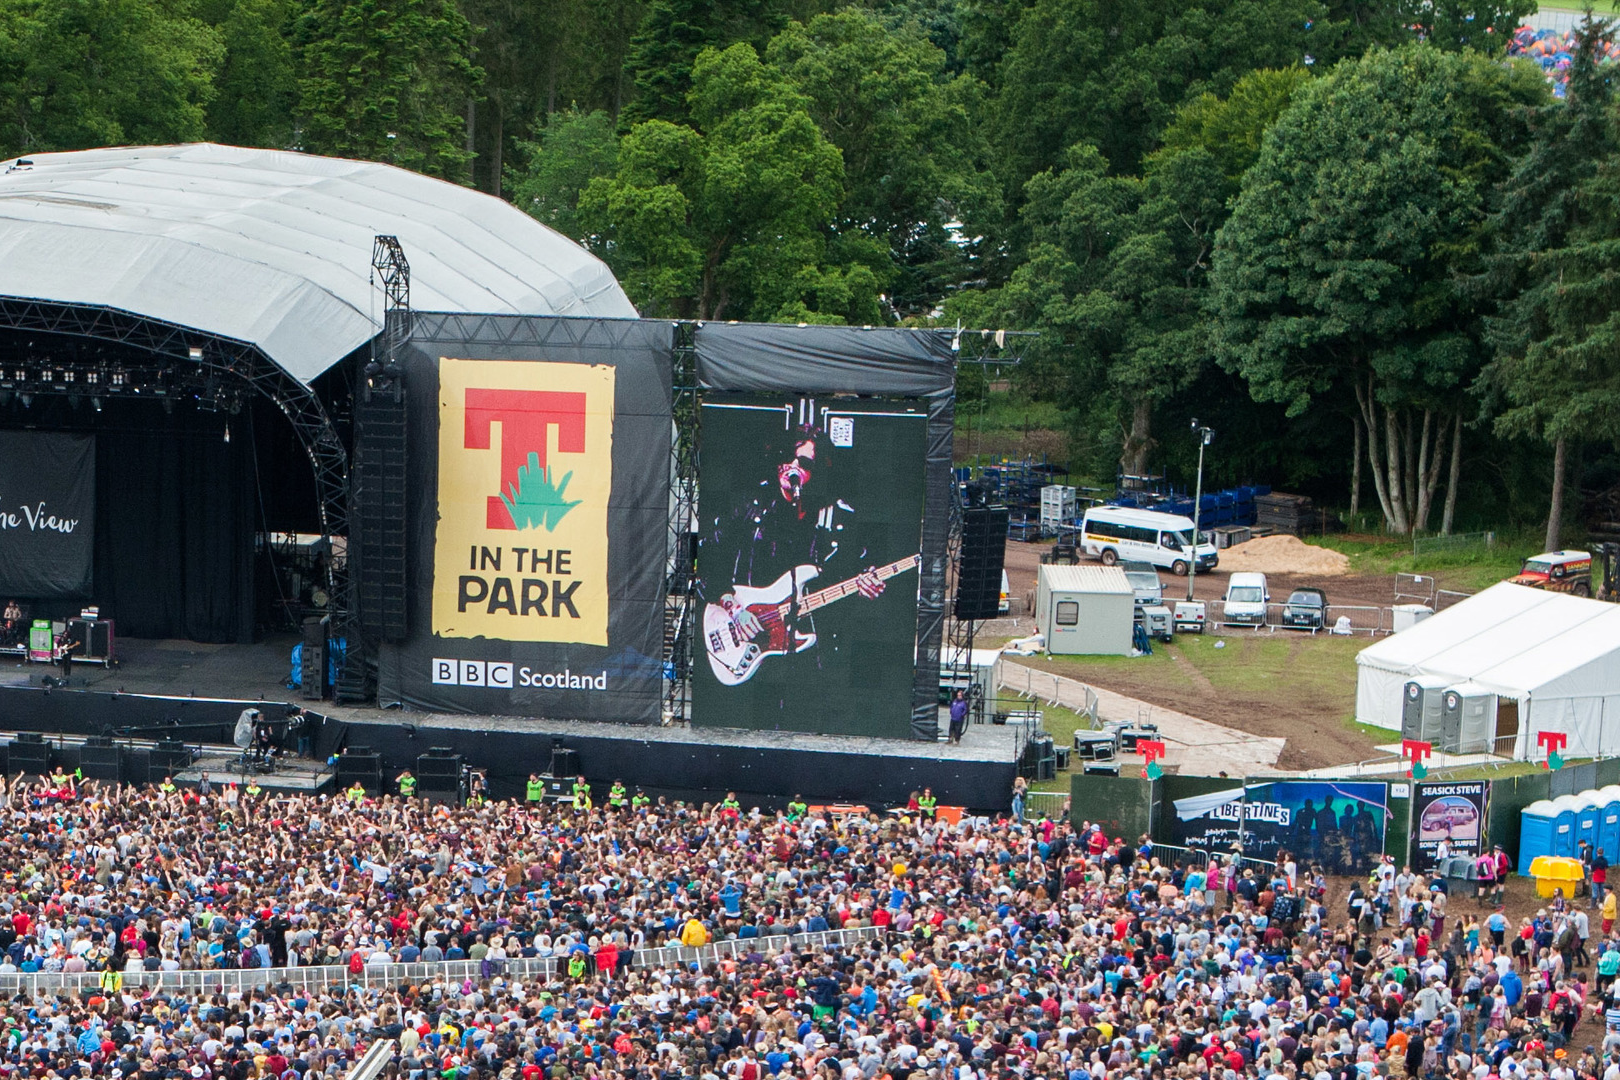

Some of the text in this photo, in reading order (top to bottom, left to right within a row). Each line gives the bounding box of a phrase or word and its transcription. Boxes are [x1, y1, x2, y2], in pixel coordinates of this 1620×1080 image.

[465, 388, 586, 530] T
[19, 501, 78, 534] View
[470, 545, 572, 575] IN THE
[457, 575, 582, 619] PARK
[433, 660, 607, 690] BBC Scotland
[1422, 785, 1481, 796] SEASICK STEVE
